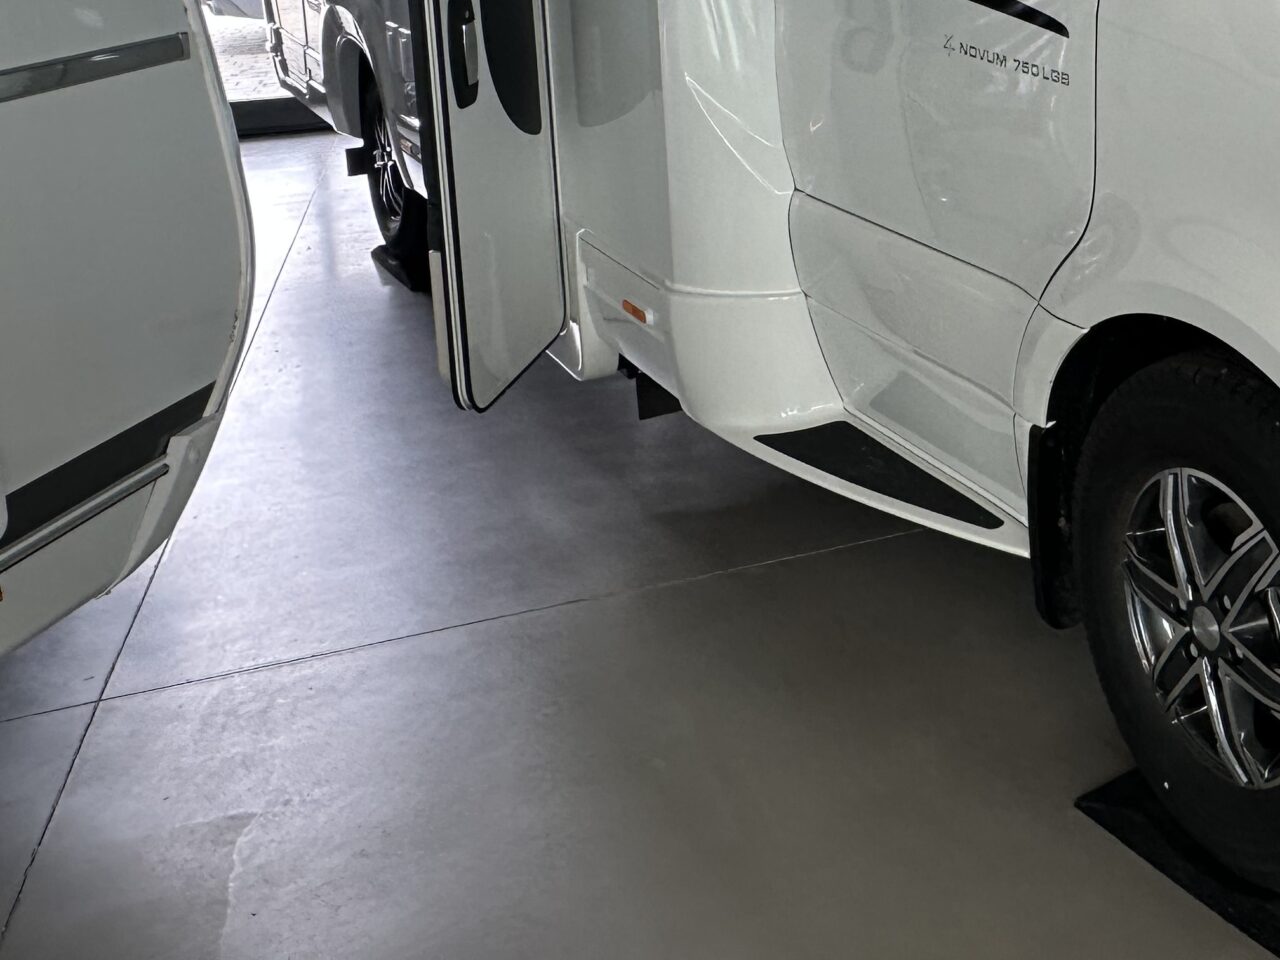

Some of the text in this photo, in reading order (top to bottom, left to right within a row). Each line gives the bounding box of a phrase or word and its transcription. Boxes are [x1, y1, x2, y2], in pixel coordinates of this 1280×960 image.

[959, 42, 1070, 86] NOVUM 750 LGB
